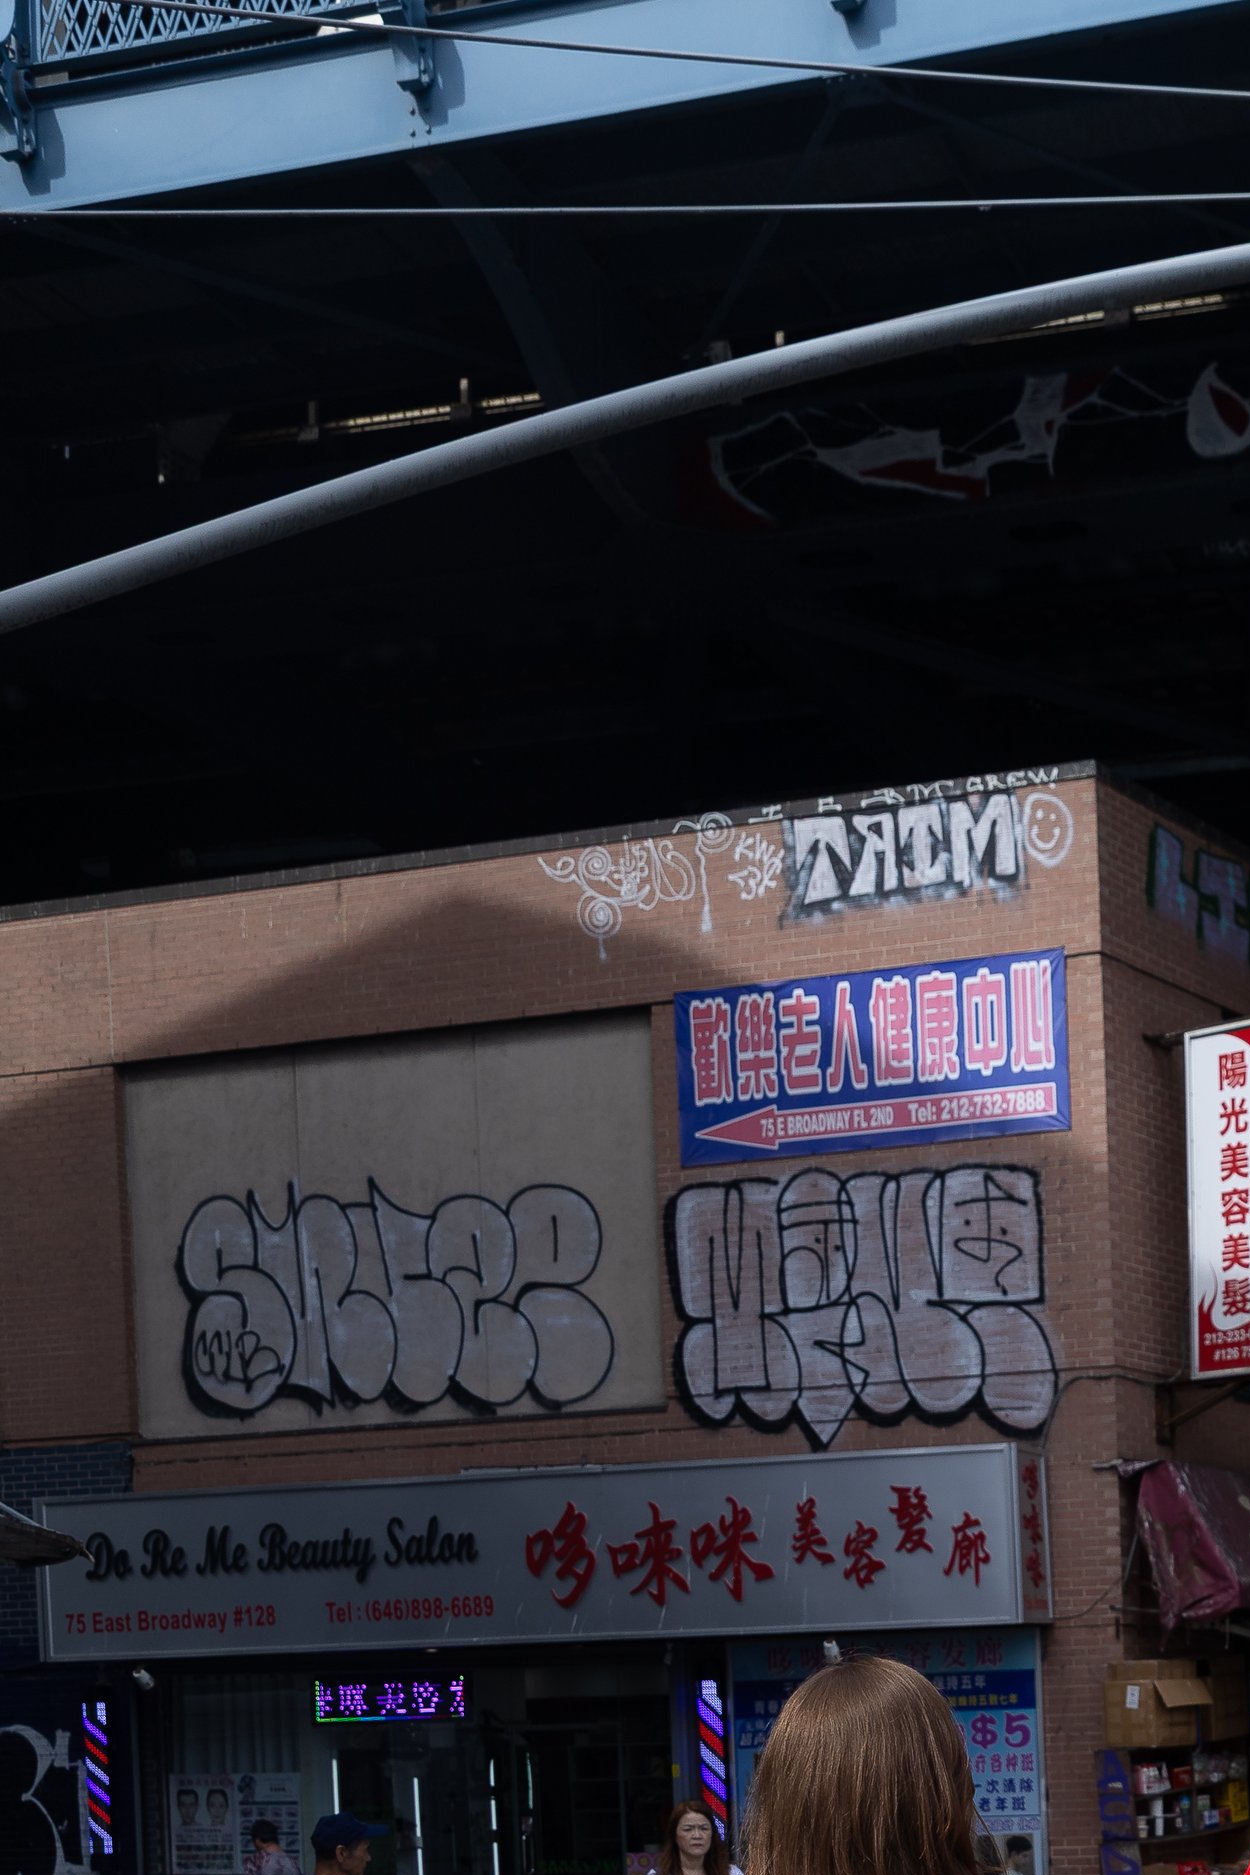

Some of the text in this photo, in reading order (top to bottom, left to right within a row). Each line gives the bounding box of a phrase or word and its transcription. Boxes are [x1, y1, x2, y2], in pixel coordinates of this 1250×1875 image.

[690, 959, 1056, 1107] 歡樂老人健康中心
[760, 1089, 1046, 1137] 75 E BROADWAY FL 2ND Tel: 212-732-7888
[1218, 1050, 1250, 1317] 陽光美容美髮
[87, 1515, 478, 1583] Do Re Me Beauty Salon
[65, 1613, 87, 1634] 75
[92, 1612, 132, 1633] East
[137, 1608, 227, 1633] Broadway
[233, 1605, 276, 1627] #128
[325, 1602, 354, 1623] Tel
[365, 1595, 494, 1621] (646)898-6689
[971, 1712, 1031, 1749] $5
